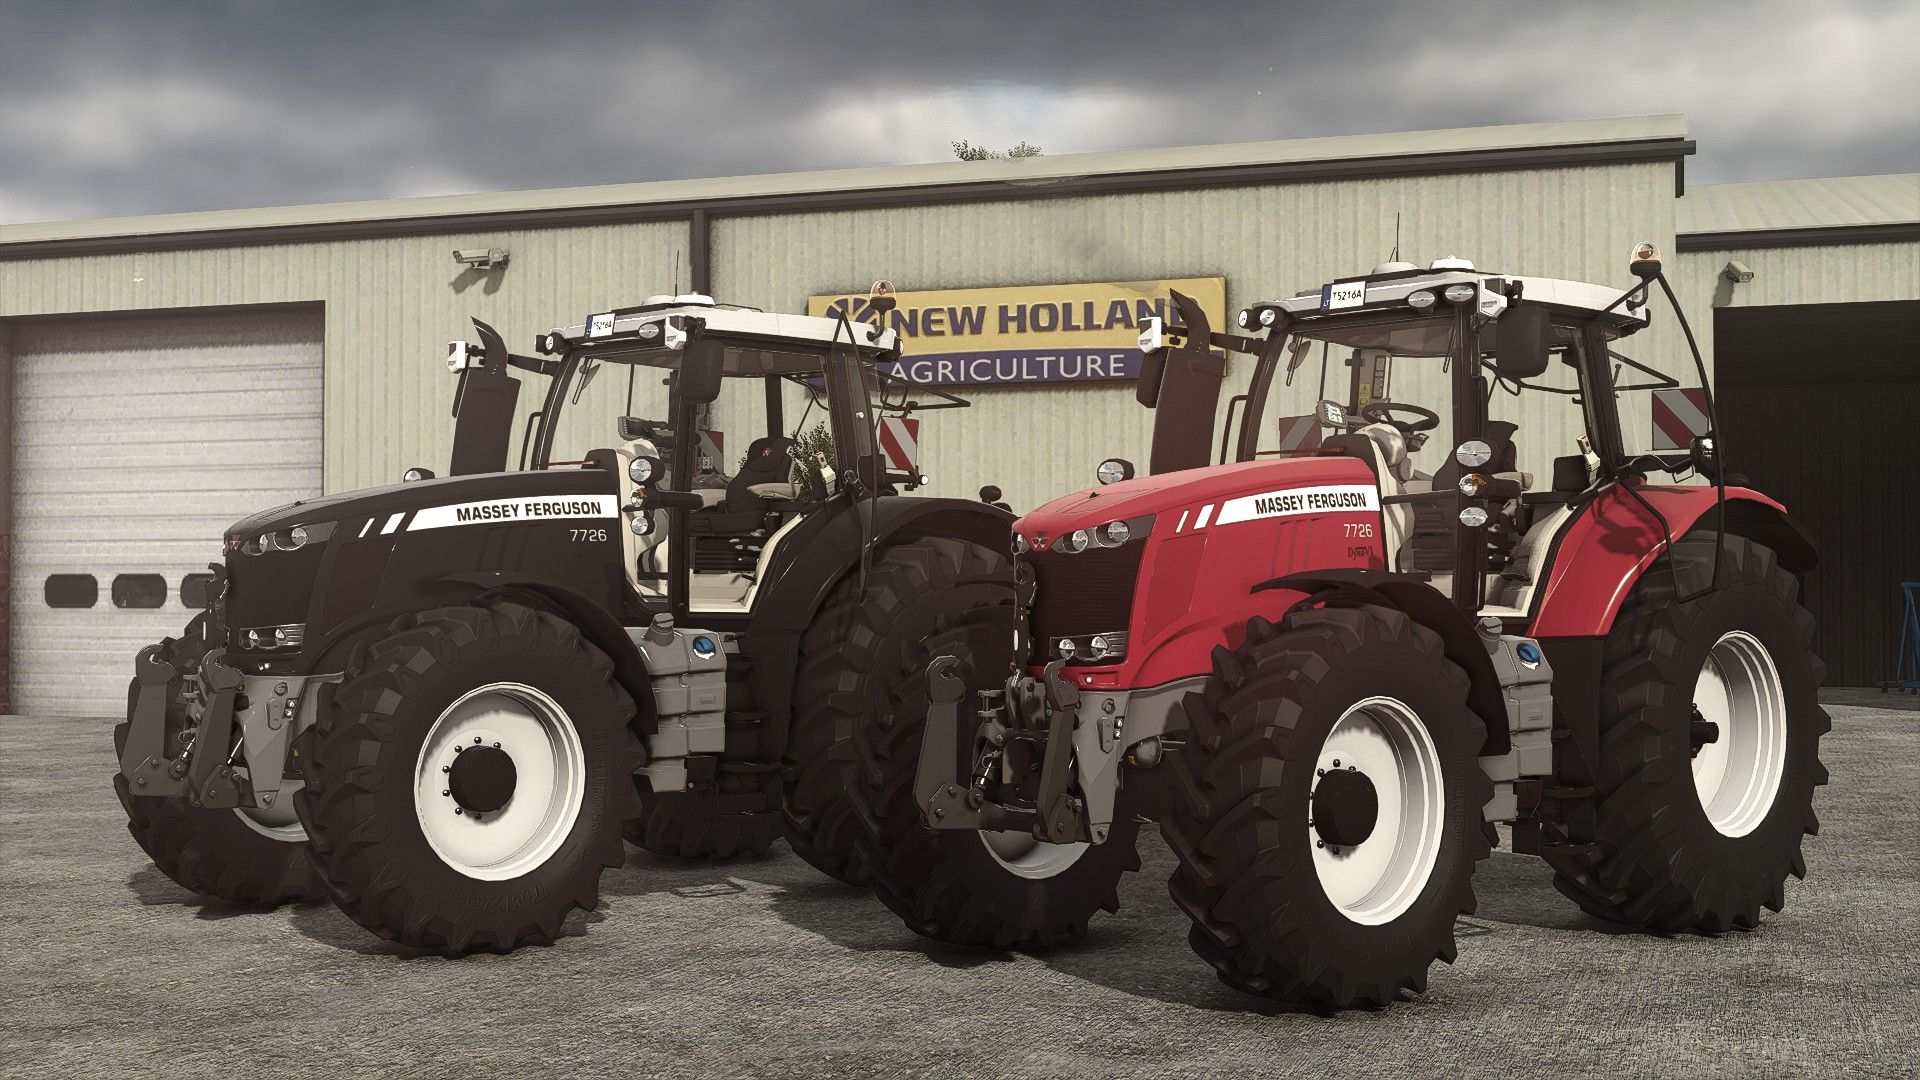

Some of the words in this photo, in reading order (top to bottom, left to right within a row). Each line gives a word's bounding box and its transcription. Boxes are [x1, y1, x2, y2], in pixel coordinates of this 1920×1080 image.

[1333, 289, 1362, 301] T5216A
[890, 306, 987, 338] NEW
[886, 354, 1126, 384] AGRICULTURE
[456, 503, 519, 522] MASSEY
[524, 501, 602, 517] FERGUSON
[1254, 494, 1305, 515] MASSEY
[1306, 492, 1367, 509] FERGUSON
[569, 529, 608, 542] 7726
[1343, 523, 1373, 538] 7726
